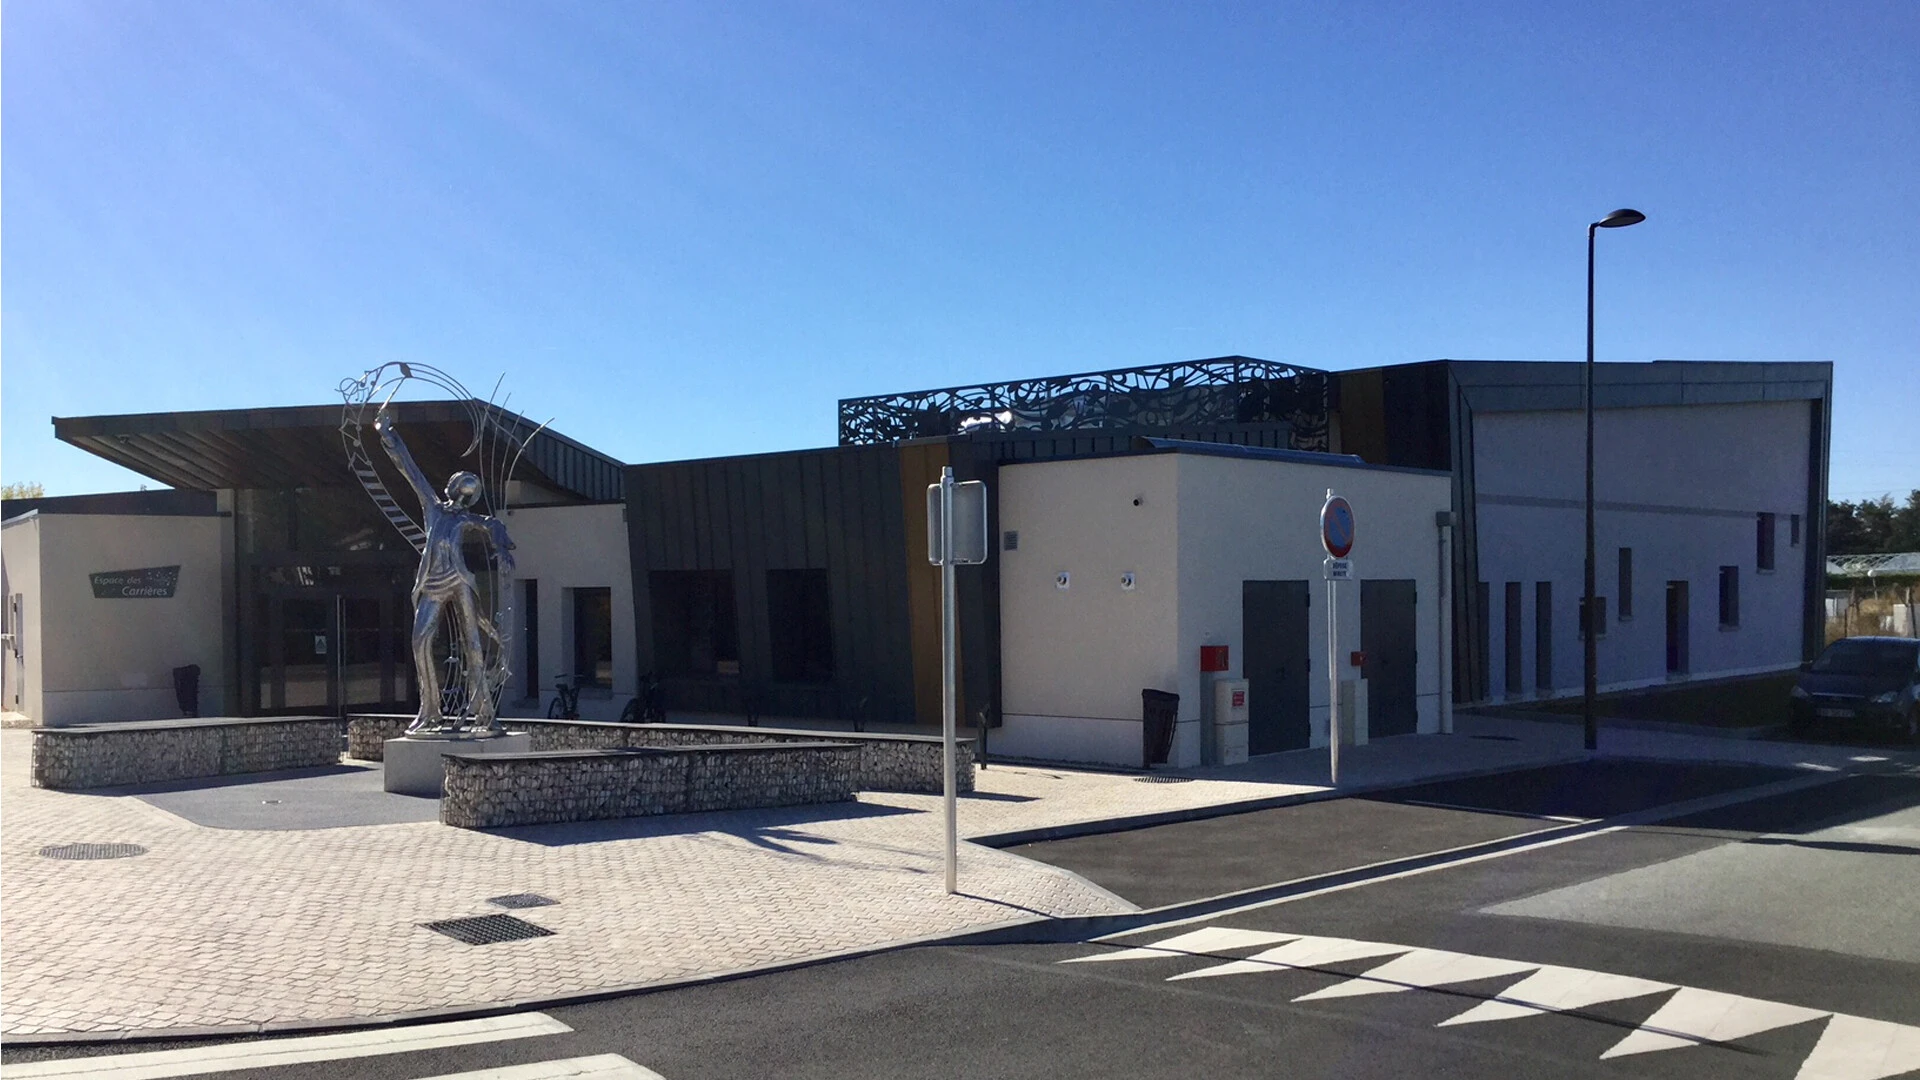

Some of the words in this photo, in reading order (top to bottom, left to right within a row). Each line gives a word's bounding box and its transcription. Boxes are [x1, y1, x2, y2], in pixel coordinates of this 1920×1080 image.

[94, 576, 124, 585] Espace
[127, 576, 141, 584] des
[121, 586, 168, 596] Carrières
